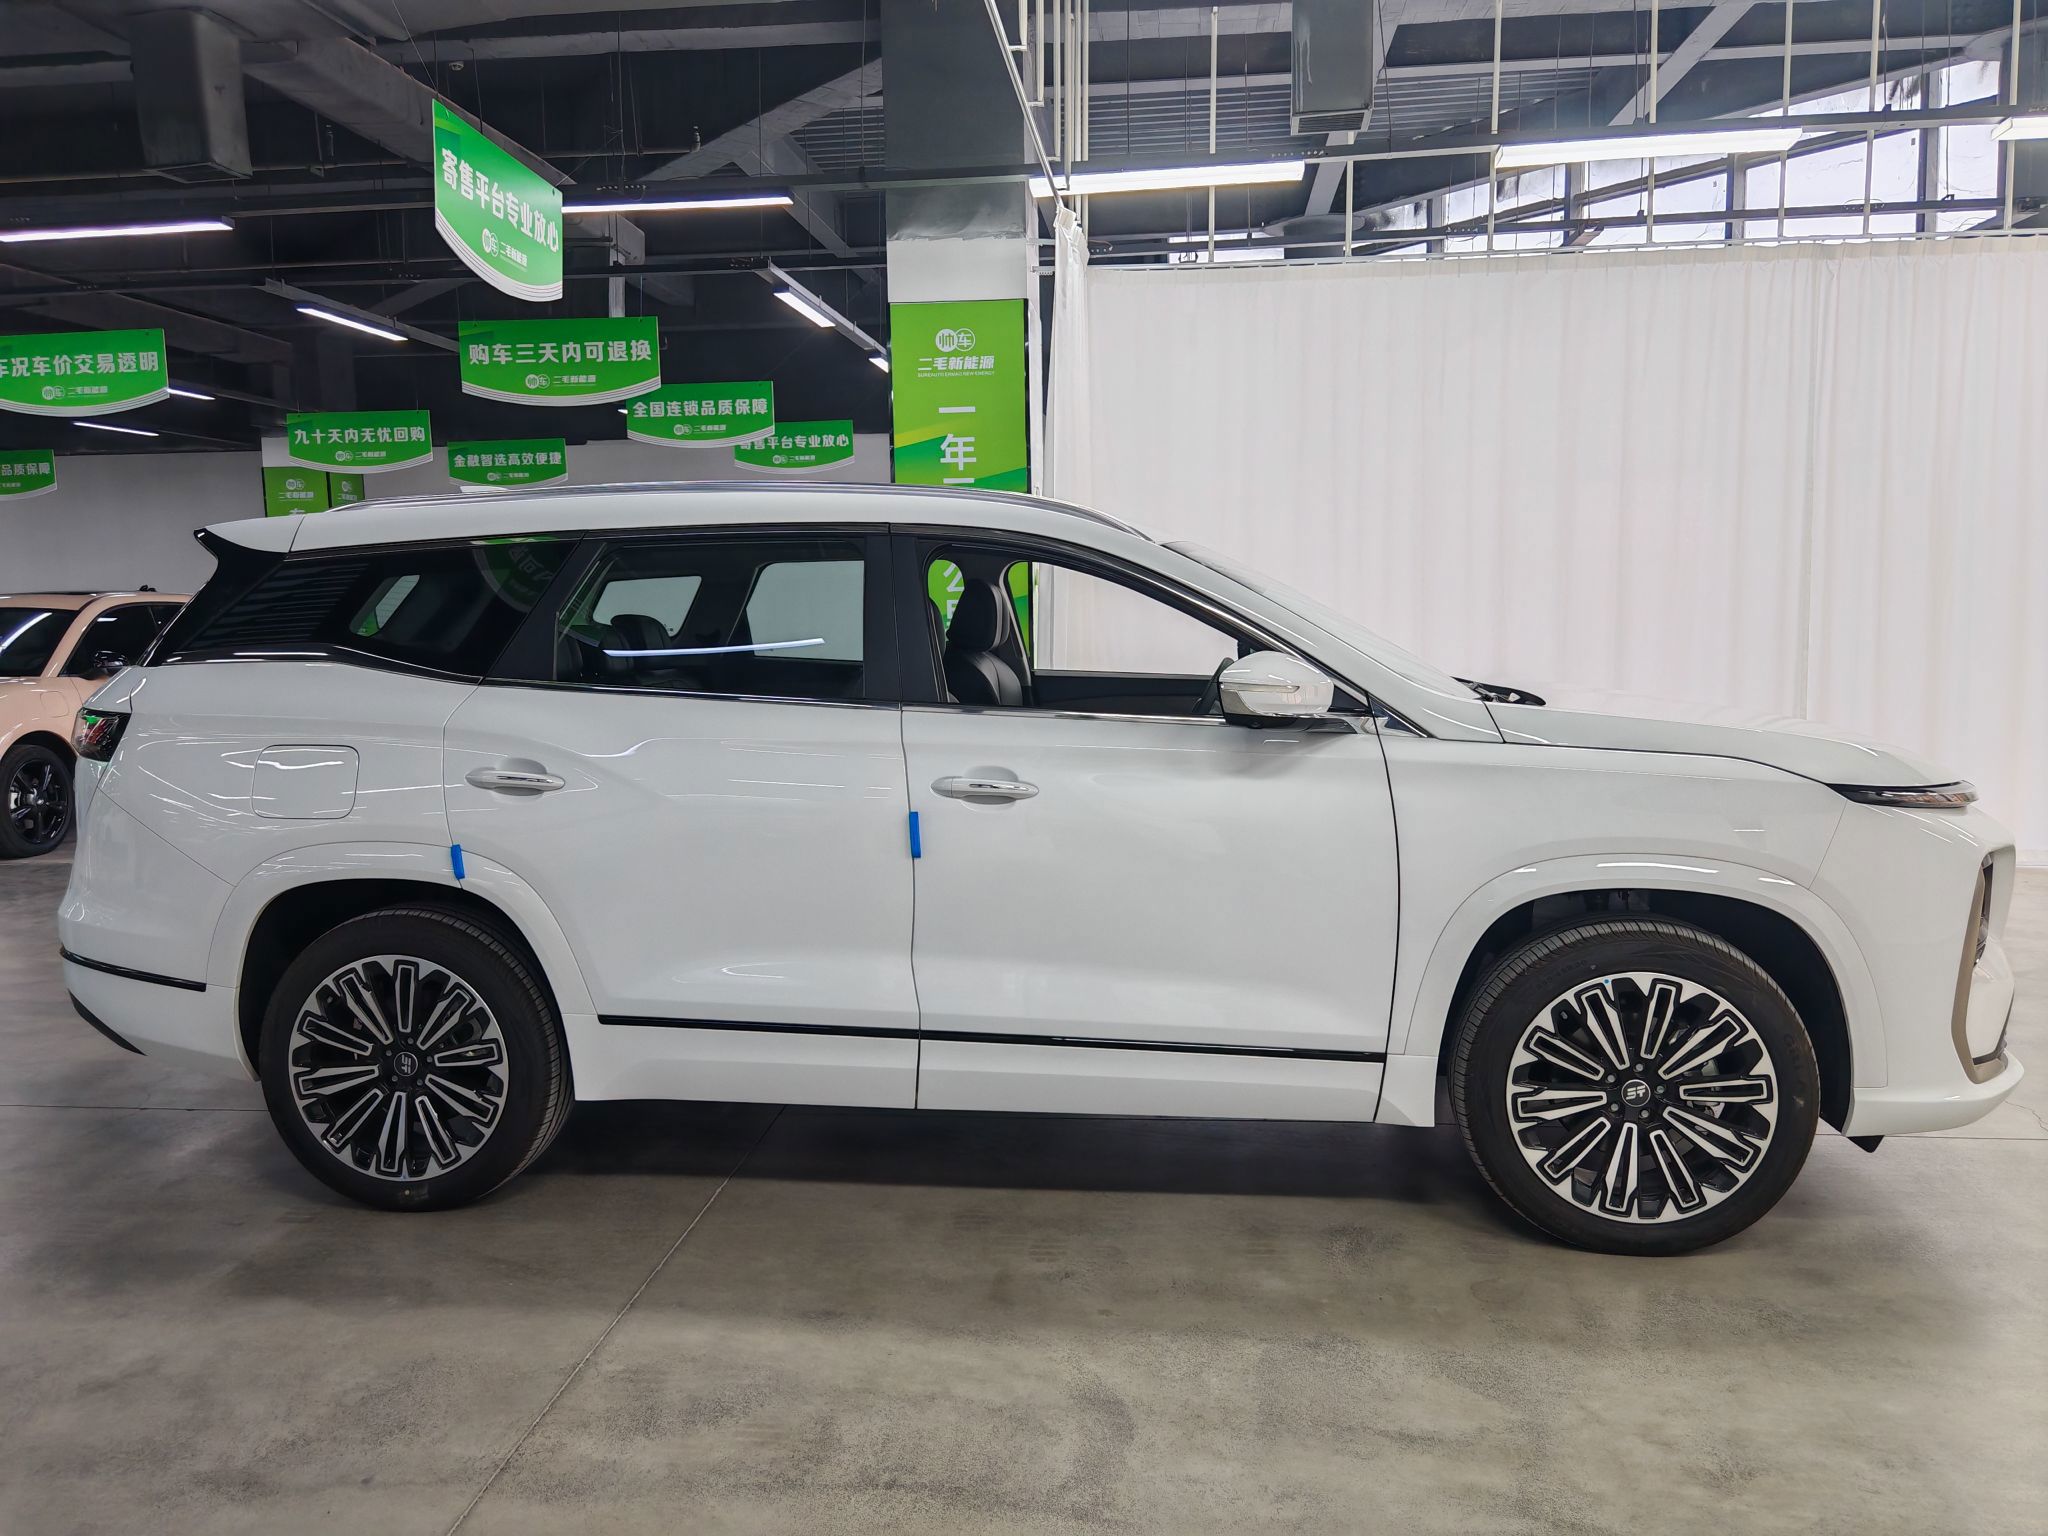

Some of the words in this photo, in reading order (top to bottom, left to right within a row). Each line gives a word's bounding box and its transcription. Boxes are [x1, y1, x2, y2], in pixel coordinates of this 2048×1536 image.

[442, 147, 559, 252] 寄售平台专业放心
[469, 339, 652, 365] 购车三天内可退换
[918, 356, 995, 371] 二毛新能源
[632, 398, 768, 418] 全国连锁品质保障
[294, 427, 426, 445] 九十天内无忧回购
[454, 452, 562, 467] 金融智选高效便捷
